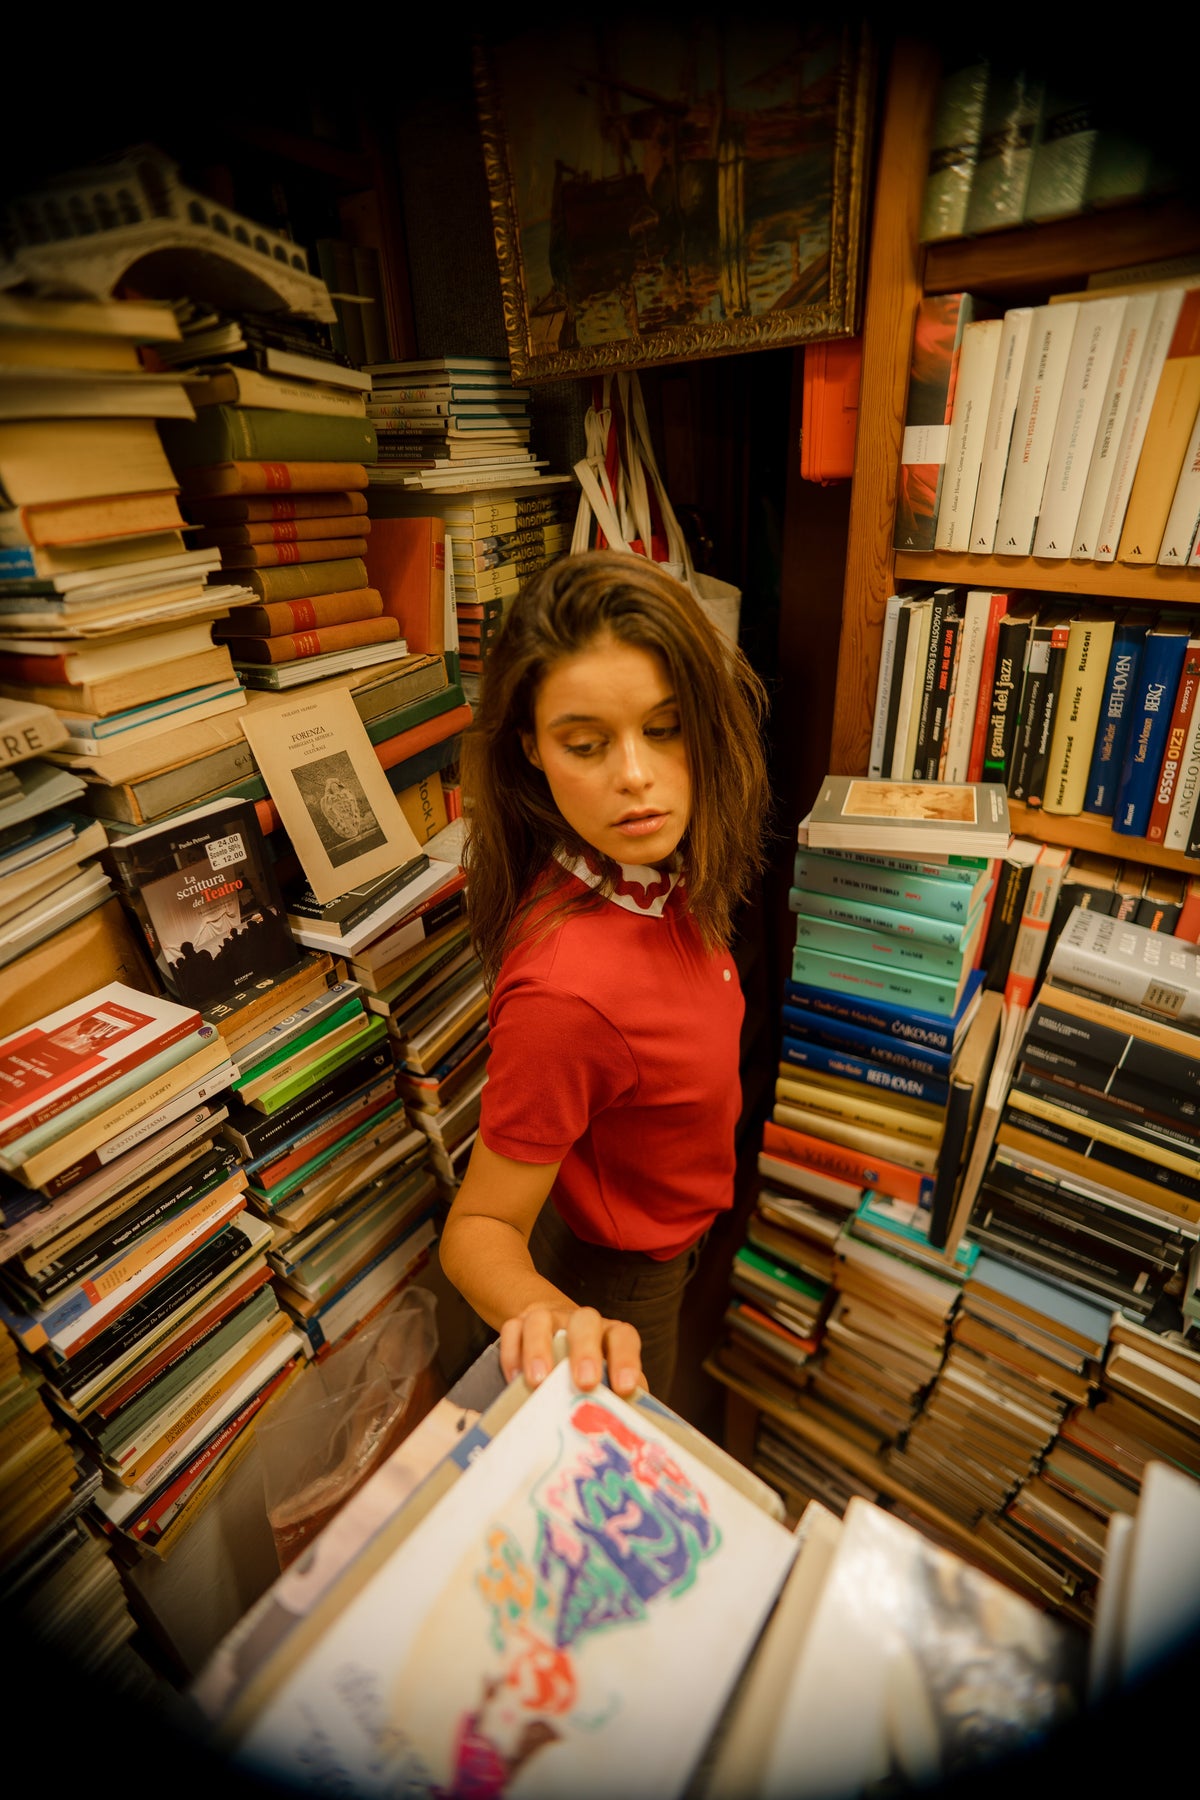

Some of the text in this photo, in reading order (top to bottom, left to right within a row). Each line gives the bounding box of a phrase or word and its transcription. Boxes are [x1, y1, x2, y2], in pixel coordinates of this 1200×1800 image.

[1030, 395, 1039, 415] CROCE
[1109, 391, 1121, 416] MORTE
[1027, 415, 1035, 436] ROSSA
[1069, 396, 1085, 448] OPERAZIONE
[1098, 416, 1115, 459] NELL'ARENA
[1022, 437, 1032, 463] ITALIANA
[517, 514, 551, 530] GAUGUIN
[509, 531, 545, 546] GAUGUIN
[510, 547, 545, 562] GAUGUIN
[928, 606, 942, 652] D'AGOSTINO
[923, 658, 936, 692] ROSSETTI
[995, 656, 1016, 689] jazz
[1106, 653, 1132, 719] BEETHOVEN
[992, 688, 1009, 712] del
[1045, 691, 1054, 707] Rock
[1142, 681, 1165, 713] BERG
[290, 723, 326, 744] FORENZA
[1054, 630, 1092, 806] Henry Barraud Berlioz Rusconi
[1138, 716, 1154, 744] Monson
[0, 727, 43, 763] RE
[987, 713, 1009, 758] grandi
[1166, 726, 1185, 760] EZIO
[1134, 743, 1147, 763] Karen
[1155, 759, 1178, 804] BOSSO
[1177, 764, 1199, 819] ANGELO
[208, 847, 228, 859] Sconto
[174, 869, 226, 901] scrittura
[183, 873, 196, 885] La
[190, 874, 244, 909] del Teatro
[865, 1066, 926, 1098] BEETHOVEN
[106, 1113, 167, 1156] QUESTO FANTASMA
[111, 1228, 133, 1246] Viaggio
[139, 1211, 155, 1225] teatro
[159, 1196, 177, 1211] Thierry
[174, 1184, 193, 1200] Salmon
[192, 1404, 205, 1417] DEL
[203, 1387, 223, 1407] MONDO
[235, 1395, 261, 1422] Pirandello
[210, 1426, 233, 1451] l'identità
[187, 1449, 212, 1475] Europea
